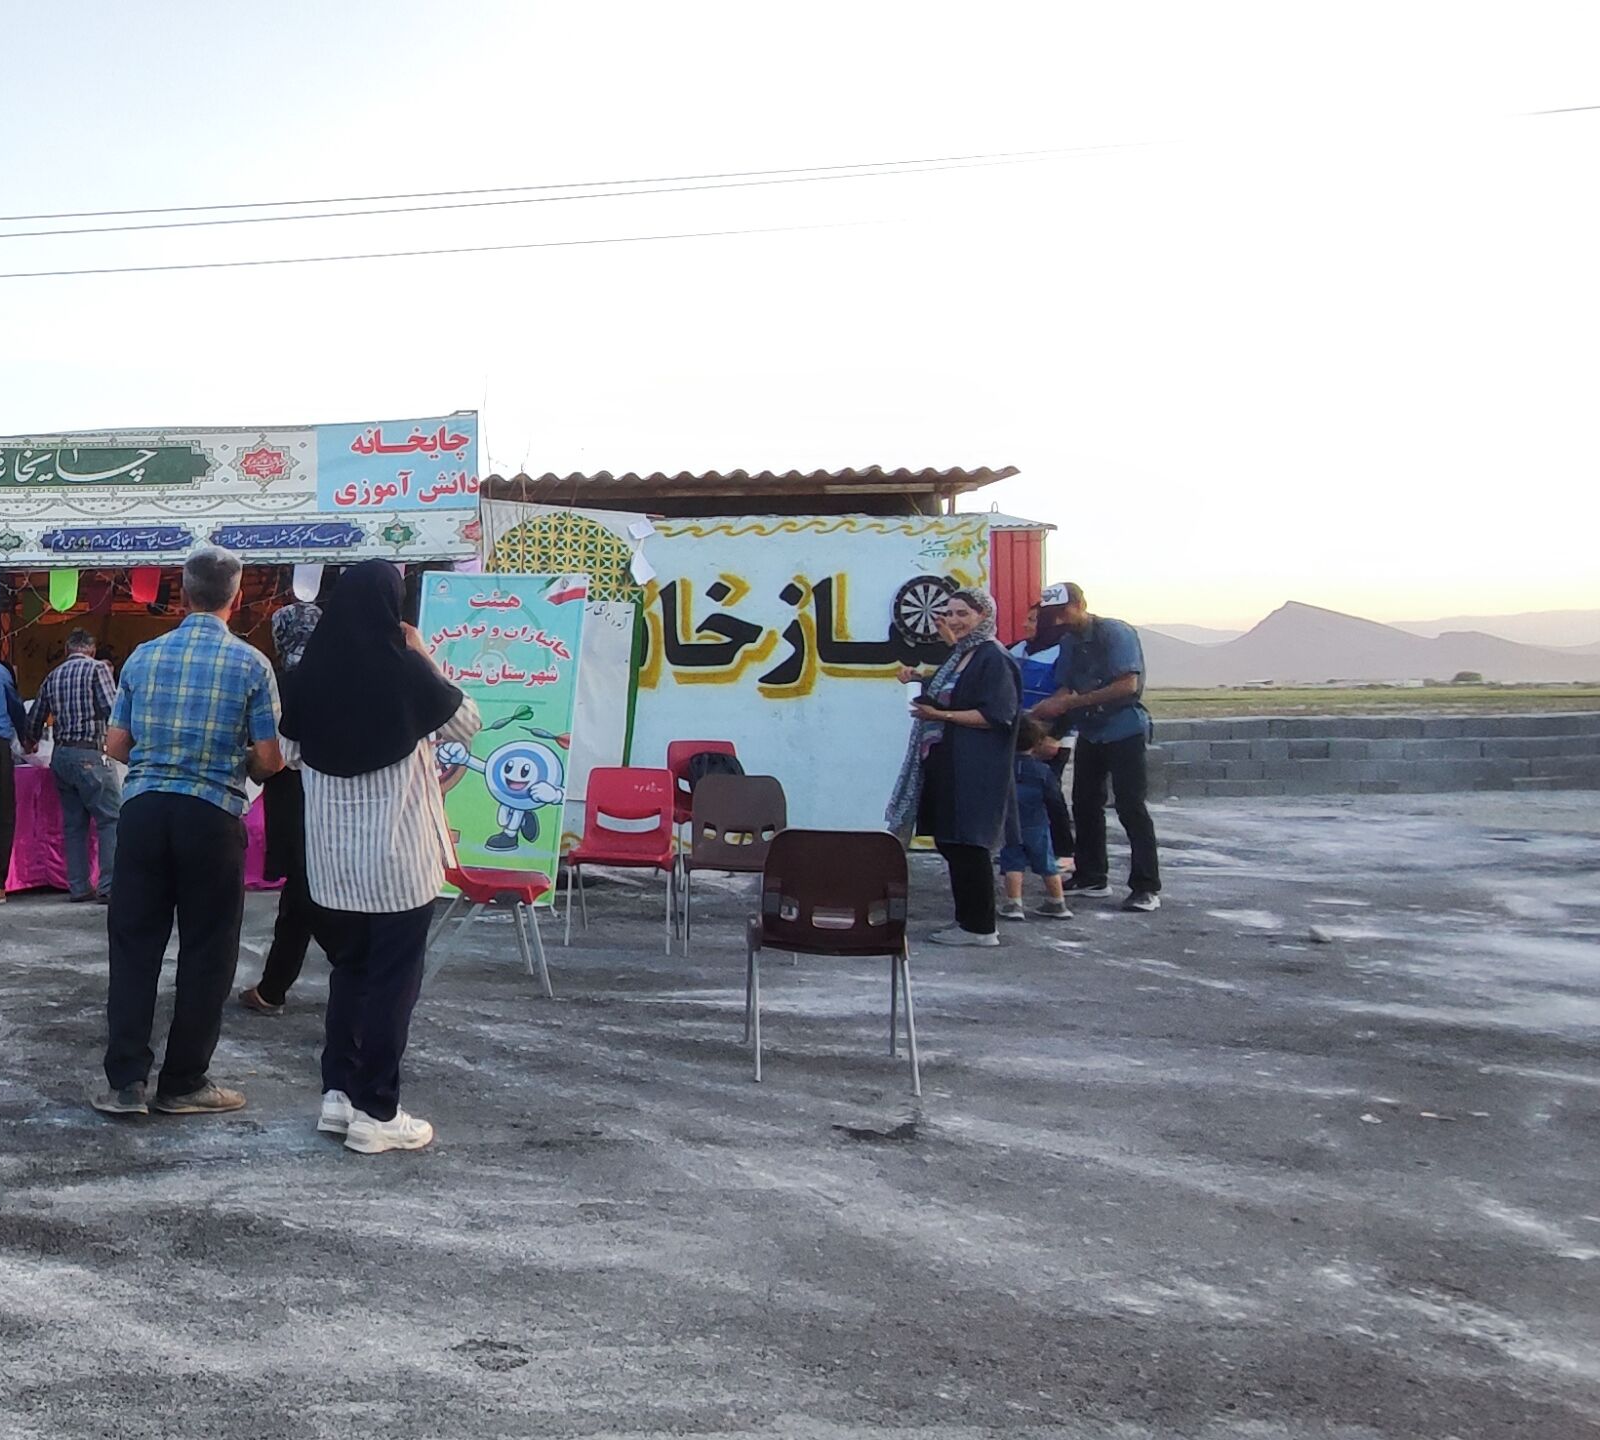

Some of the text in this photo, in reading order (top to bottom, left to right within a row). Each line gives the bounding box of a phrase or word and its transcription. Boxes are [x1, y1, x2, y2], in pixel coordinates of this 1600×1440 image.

[351, 425, 470, 460] چایخانه
[335, 471, 480, 506] دانش آموزی
[469, 591, 521, 612] هیئت
[491, 626, 500, 637] و
[504, 626, 571, 661] جانبازان
[442, 660, 558, 687] شهرستان شیروا
